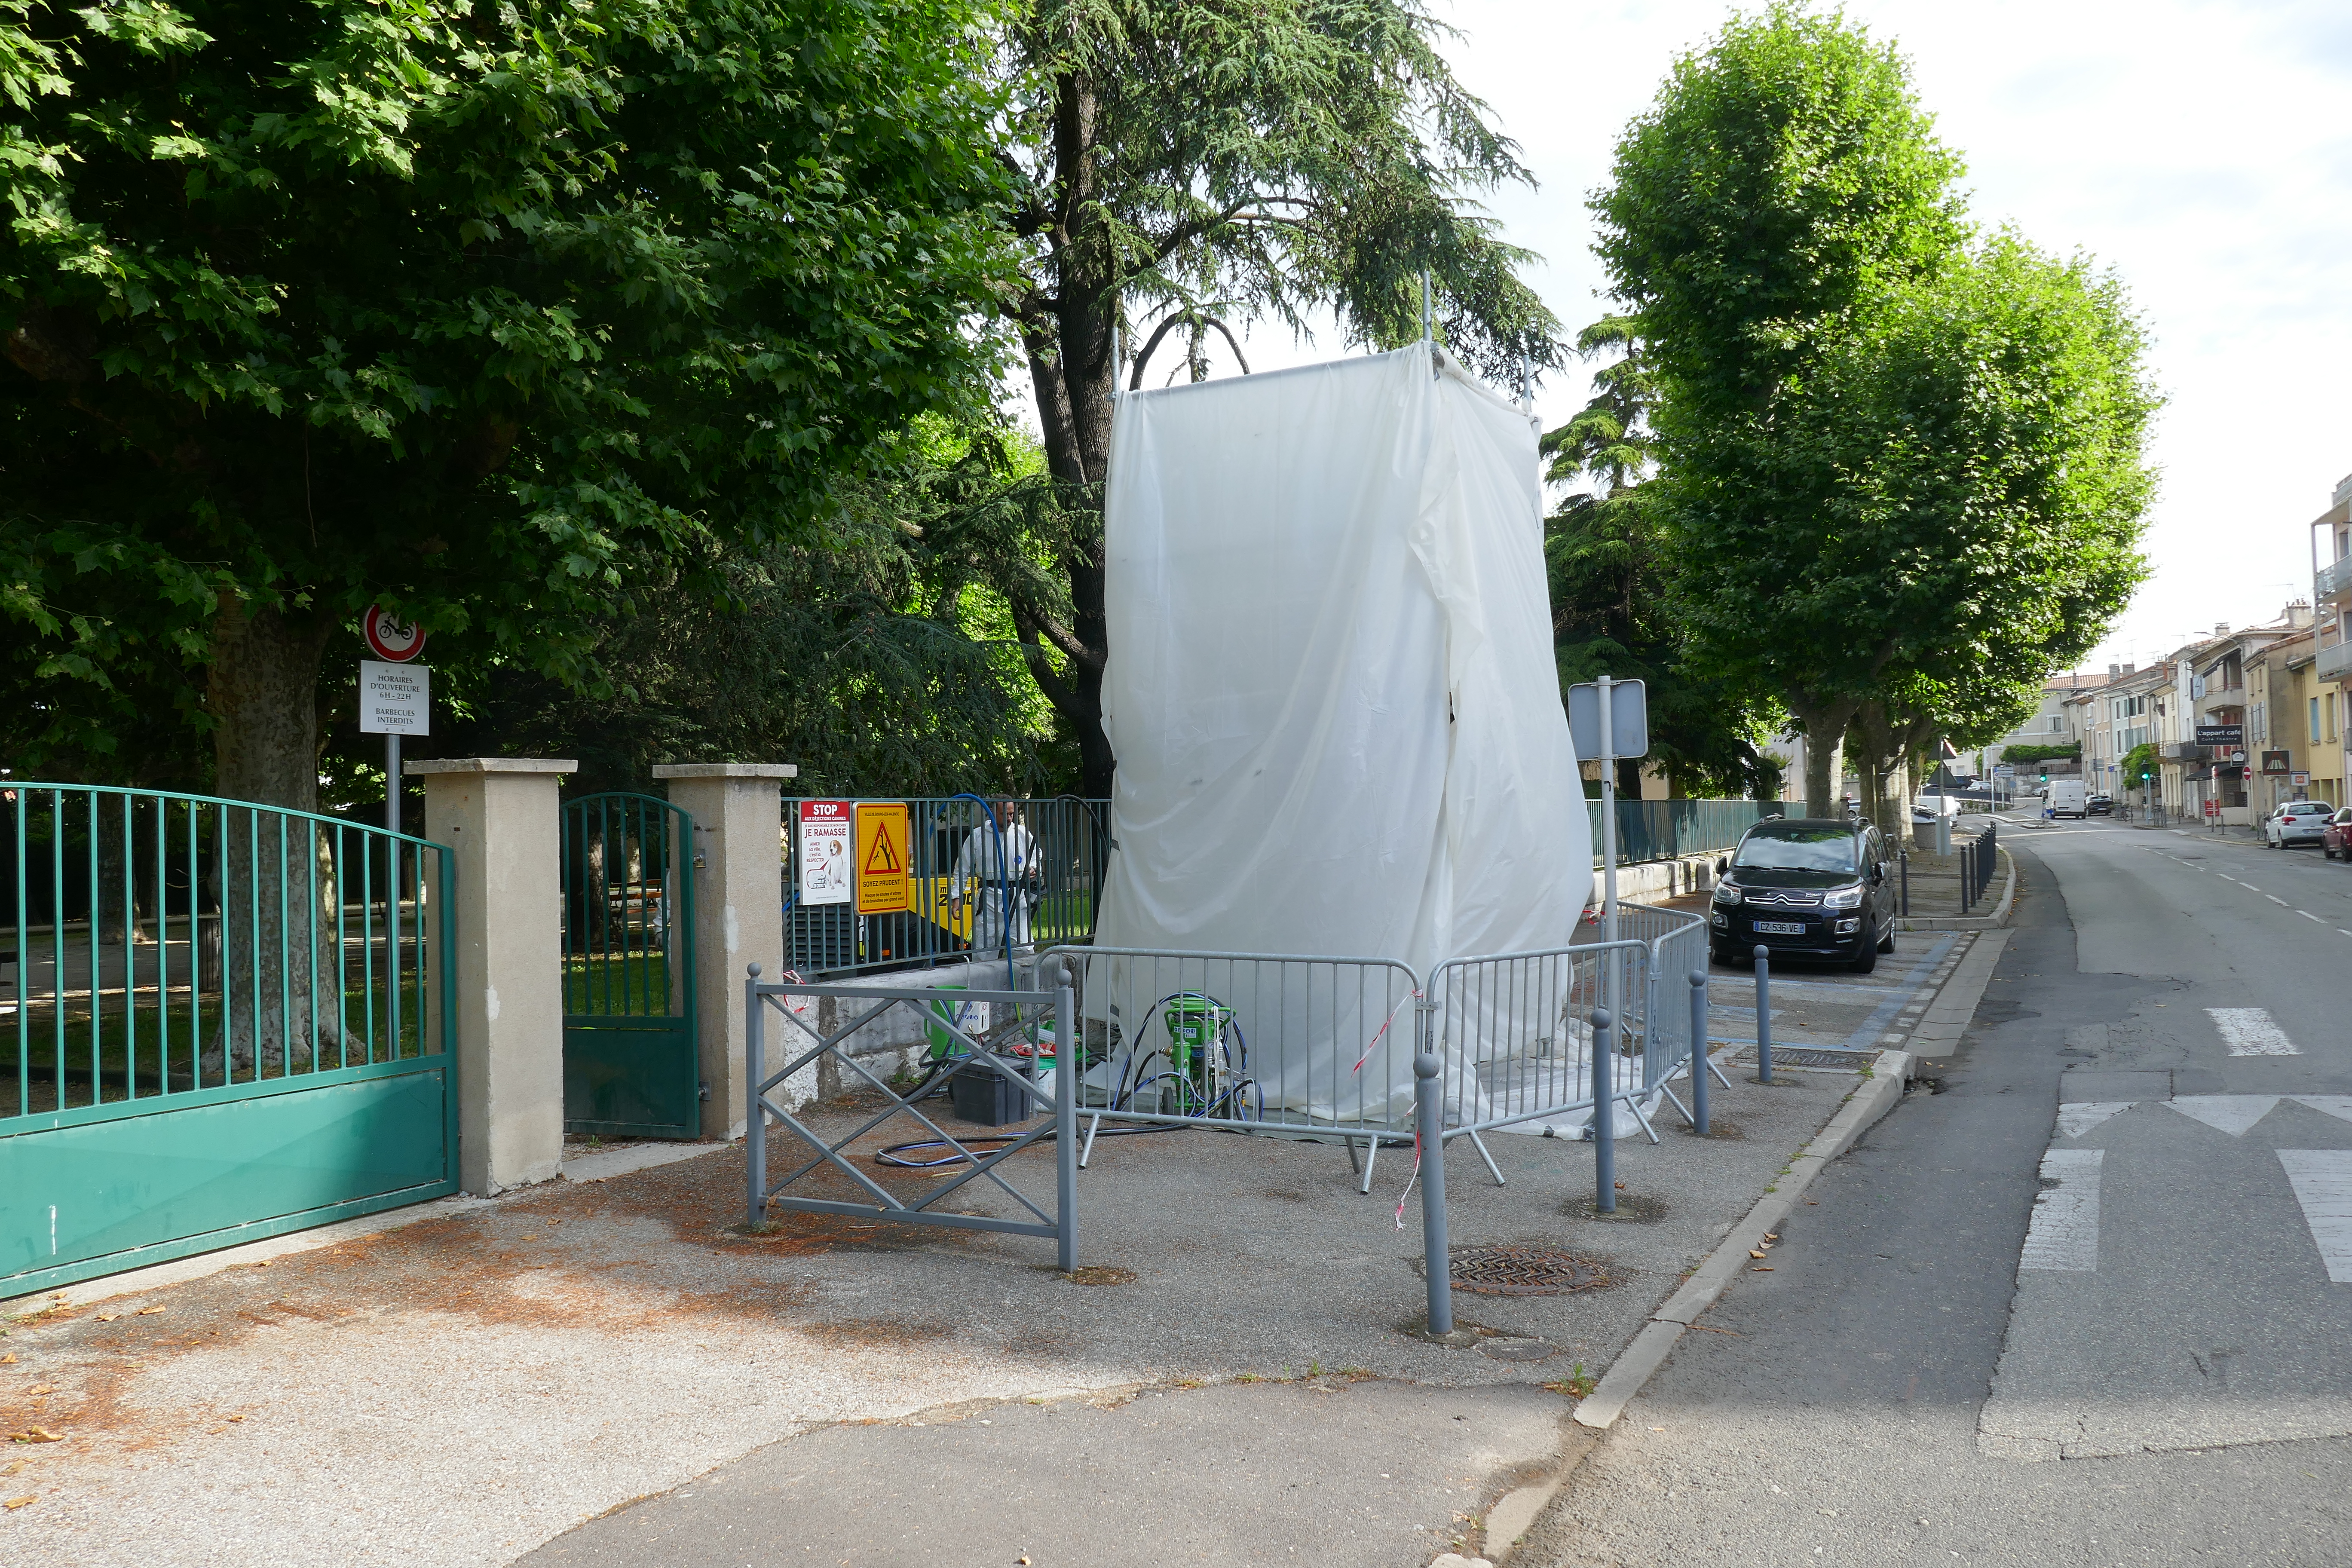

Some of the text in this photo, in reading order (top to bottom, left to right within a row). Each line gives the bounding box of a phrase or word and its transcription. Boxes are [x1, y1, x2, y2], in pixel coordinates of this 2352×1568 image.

[378, 675, 413, 683] HORAIRES
[371, 683, 420, 692] D'OUVERTURE
[376, 708, 415, 717] BARBECUES
[813, 804, 838, 815] STOP
[804, 828, 846, 839] JE RAMASSE
[1761, 923, 1798, 932] CZ-536-VE
